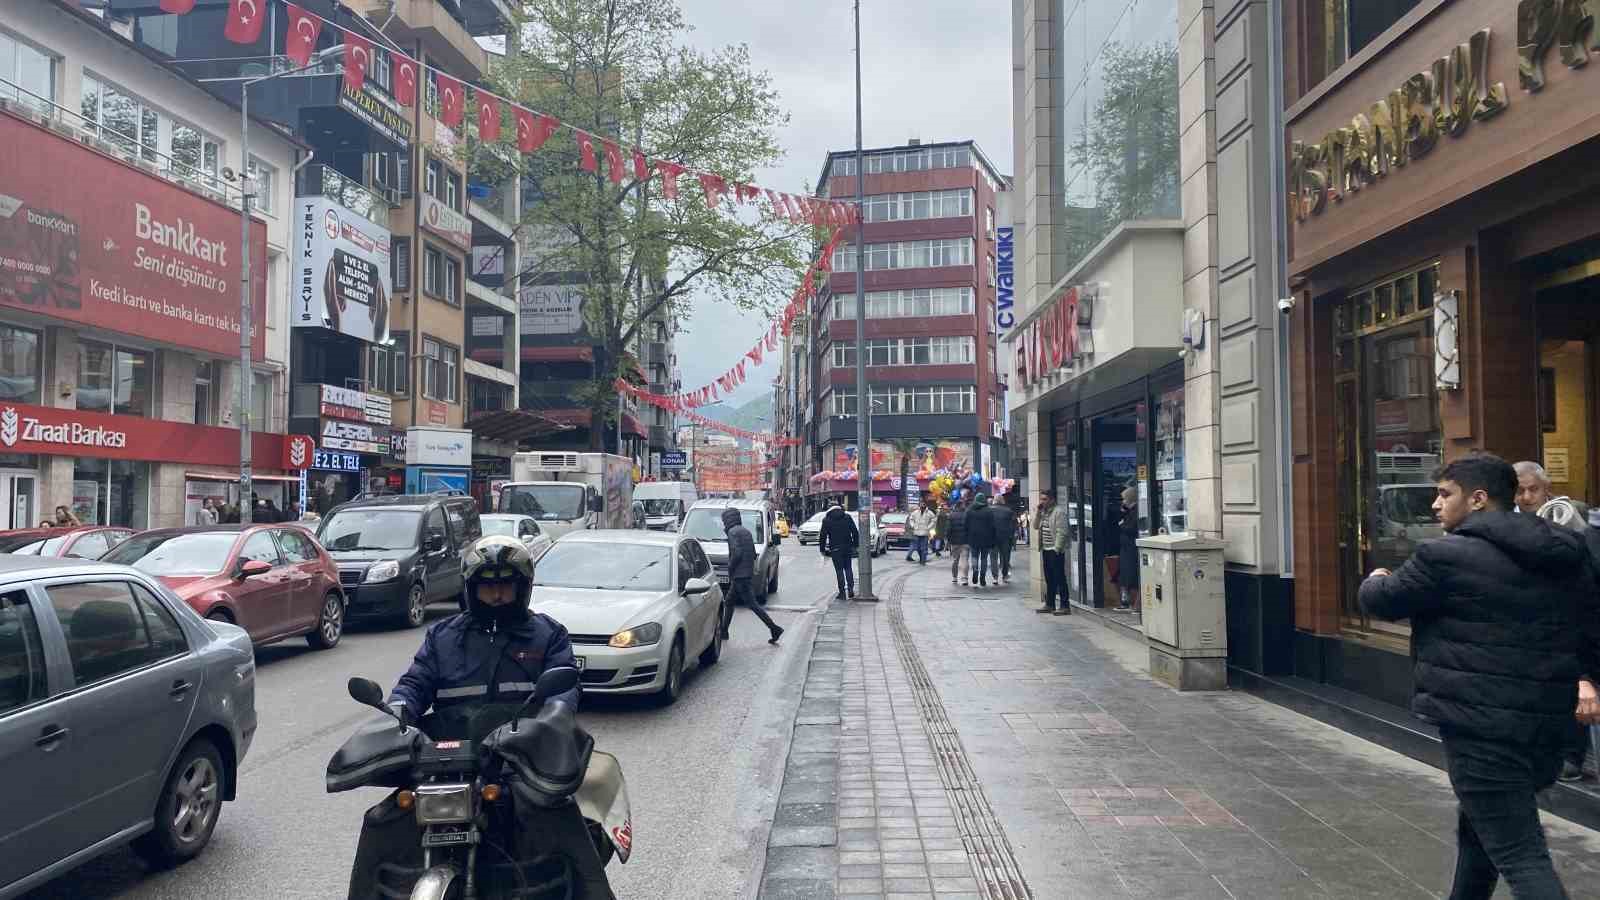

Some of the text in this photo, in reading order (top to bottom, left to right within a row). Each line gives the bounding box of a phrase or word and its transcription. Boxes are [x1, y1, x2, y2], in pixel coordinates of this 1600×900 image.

[135, 202, 228, 267] Bankkart
[134, 247, 164, 274] Seni
[166, 261, 216, 289] düşünür
[90, 279, 121, 303] Kredi
[123, 288, 147, 311] kartı
[150, 301, 161, 314] ve
[163, 299, 193, 322] banka
[22, 418, 126, 448] Ziraat Bankası
